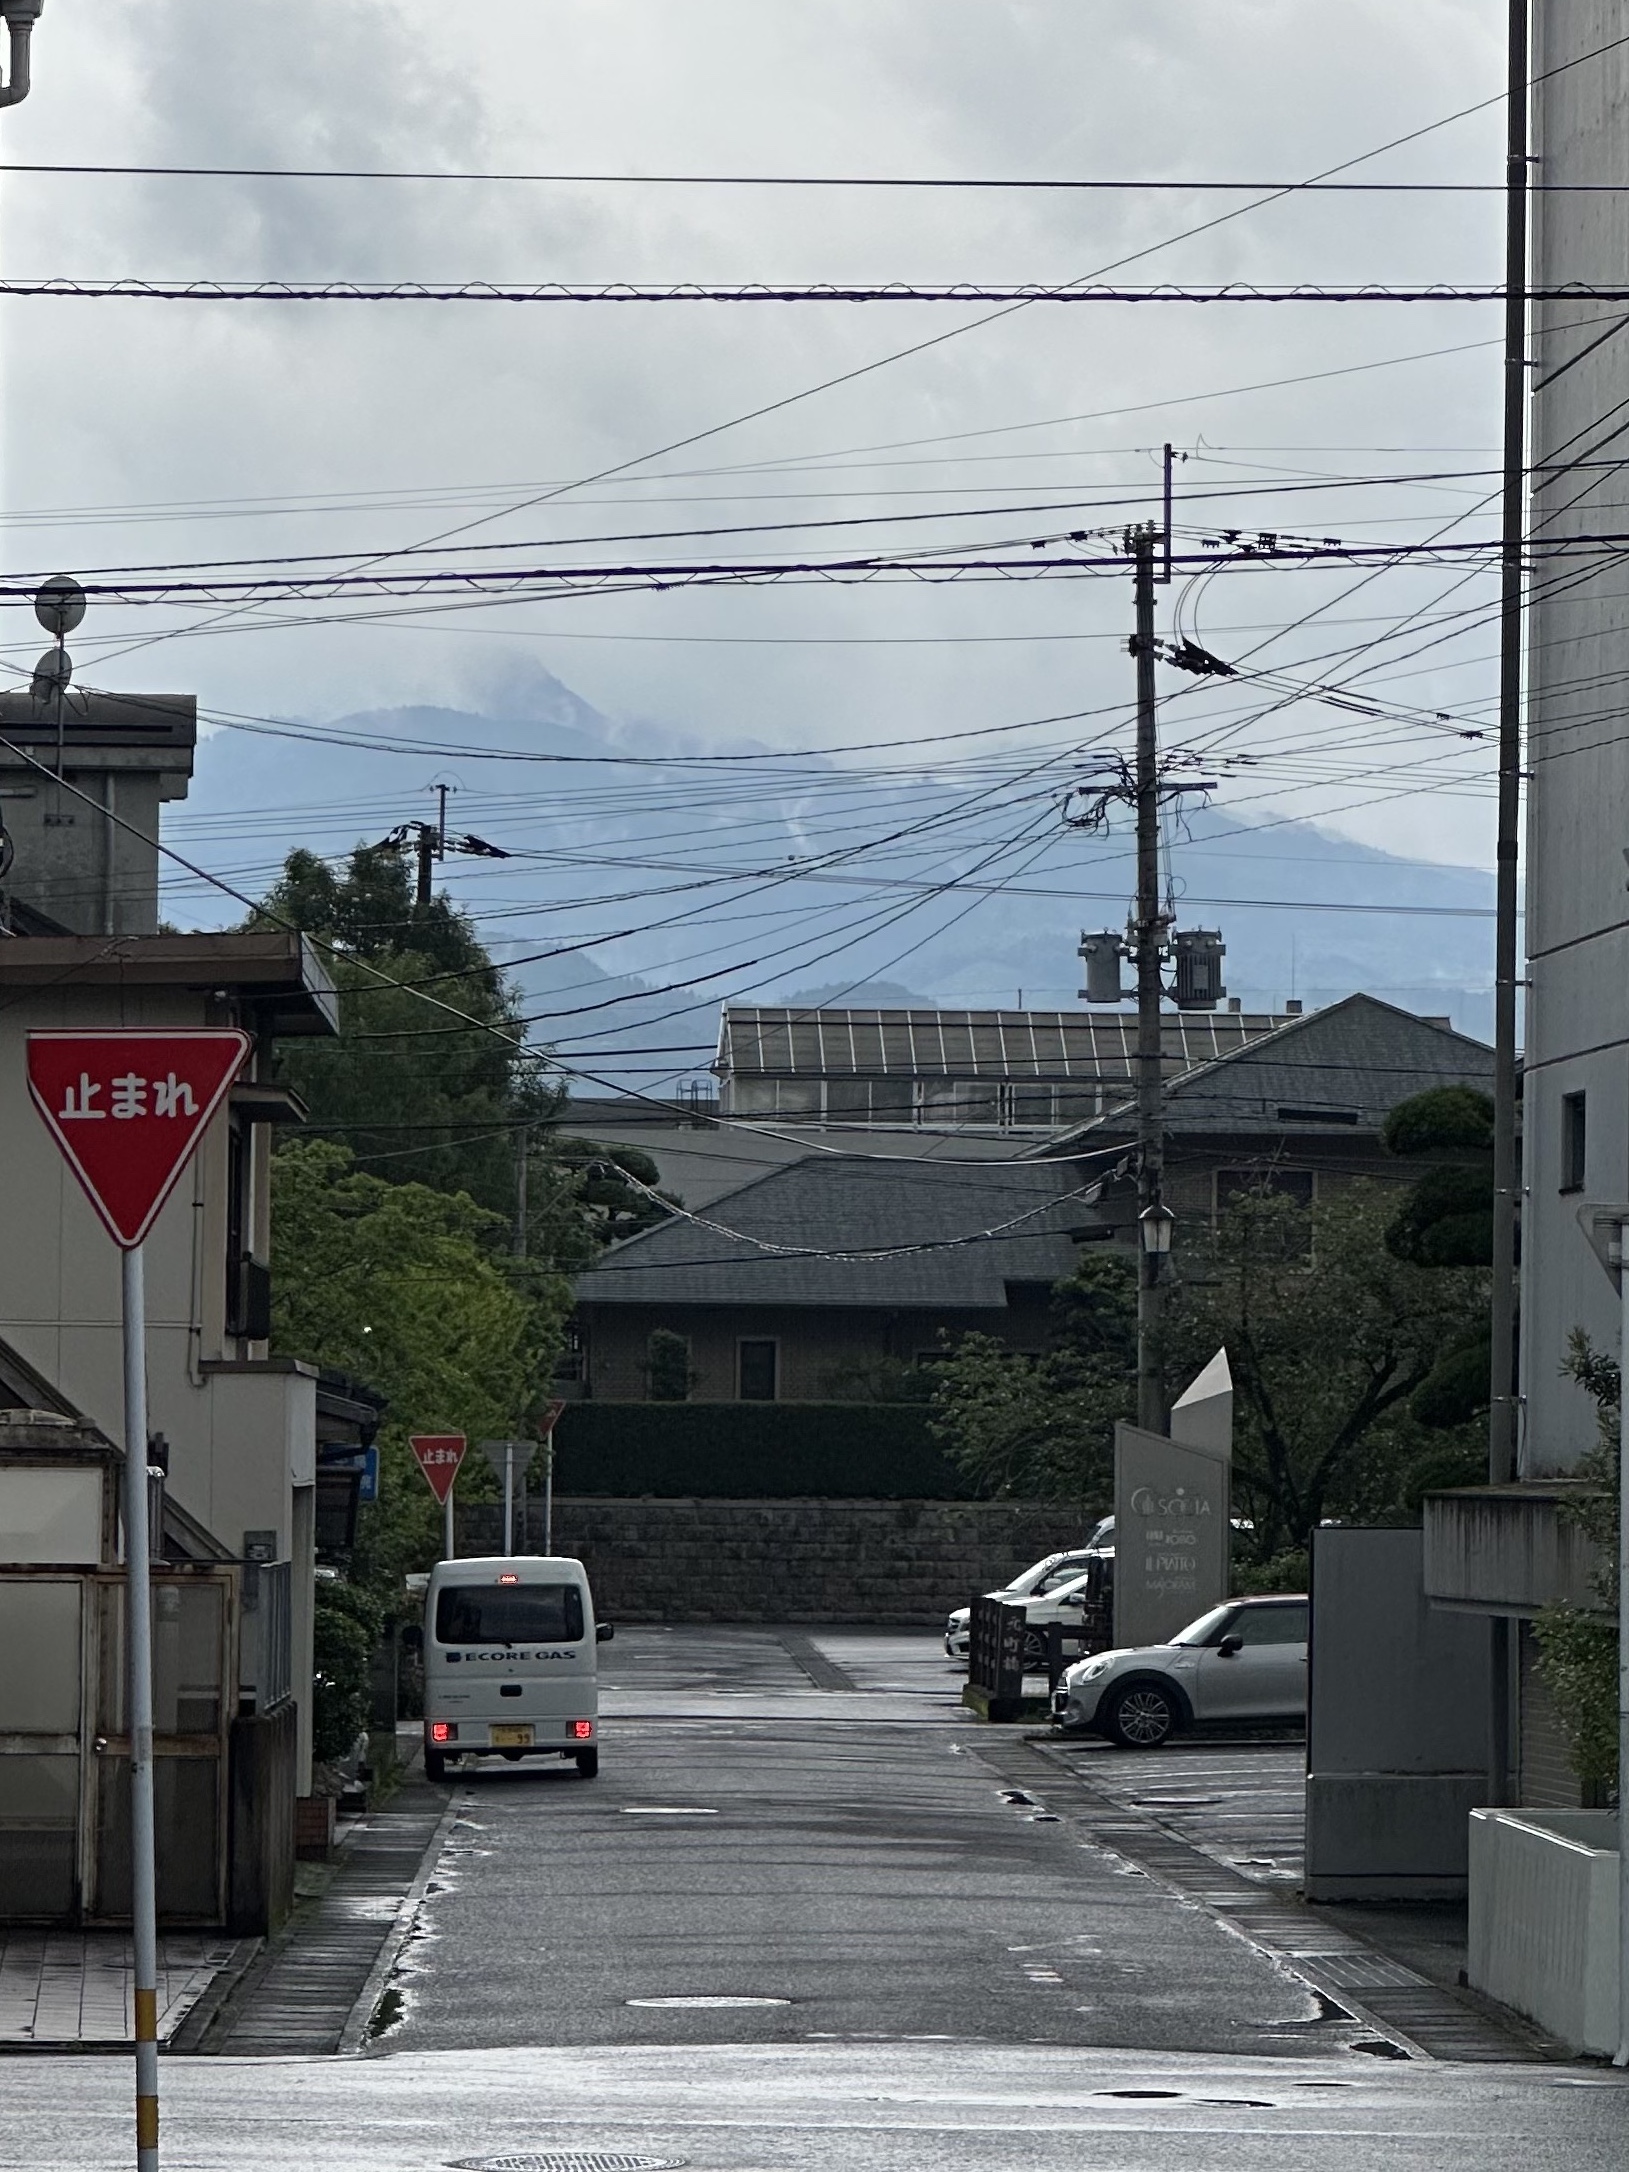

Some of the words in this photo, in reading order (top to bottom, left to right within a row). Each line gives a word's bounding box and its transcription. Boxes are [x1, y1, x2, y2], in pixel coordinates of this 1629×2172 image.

[58, 1072, 200, 1119] 止まれ
[422, 1448, 459, 1465] 止まれ
[465, 1651, 531, 1662] ECORE
[535, 1650, 577, 1660] GAS
